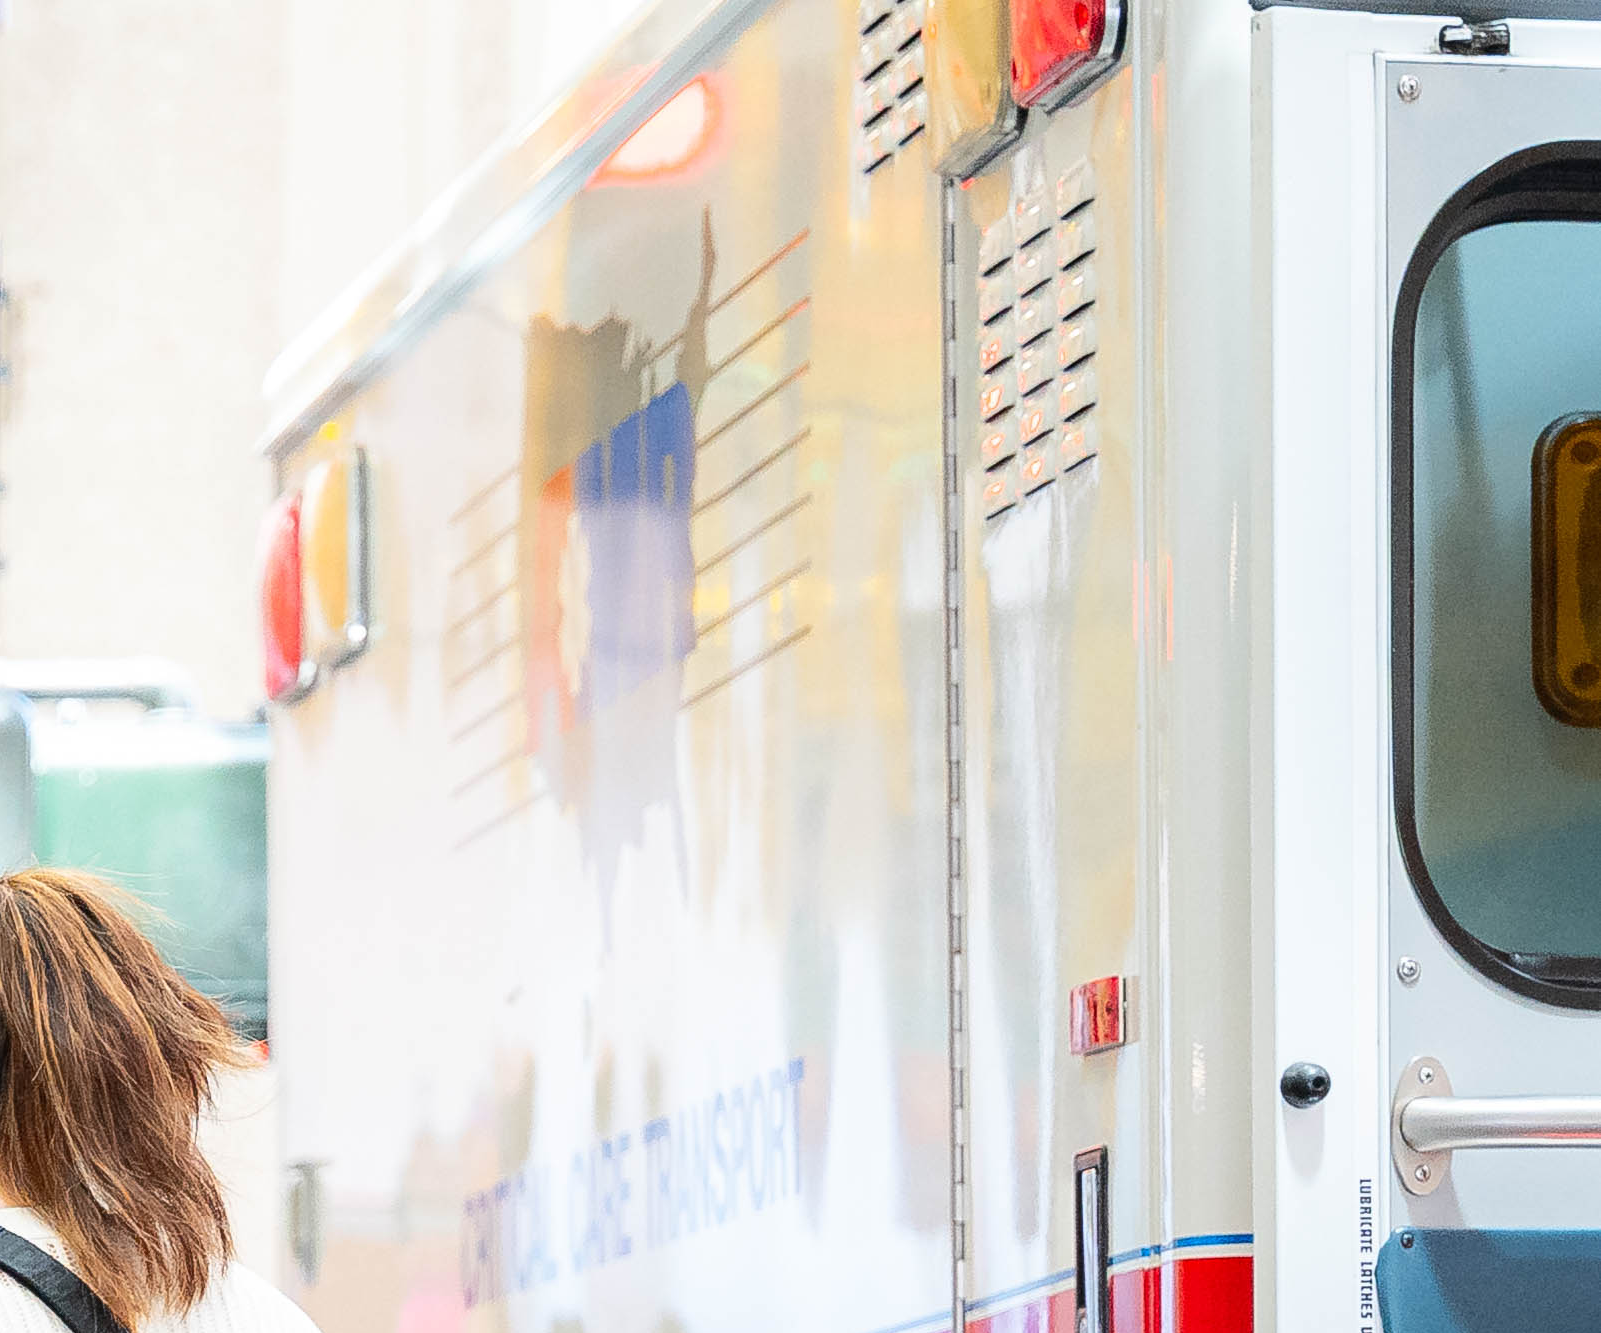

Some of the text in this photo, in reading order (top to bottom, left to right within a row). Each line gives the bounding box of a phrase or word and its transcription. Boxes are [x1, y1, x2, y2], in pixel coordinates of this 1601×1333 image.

[642, 1055, 805, 1250] TRANSPORT
[1359, 1178, 1372, 1253] LUBRICATE
[1360, 1262, 1373, 1319] LATCHES
